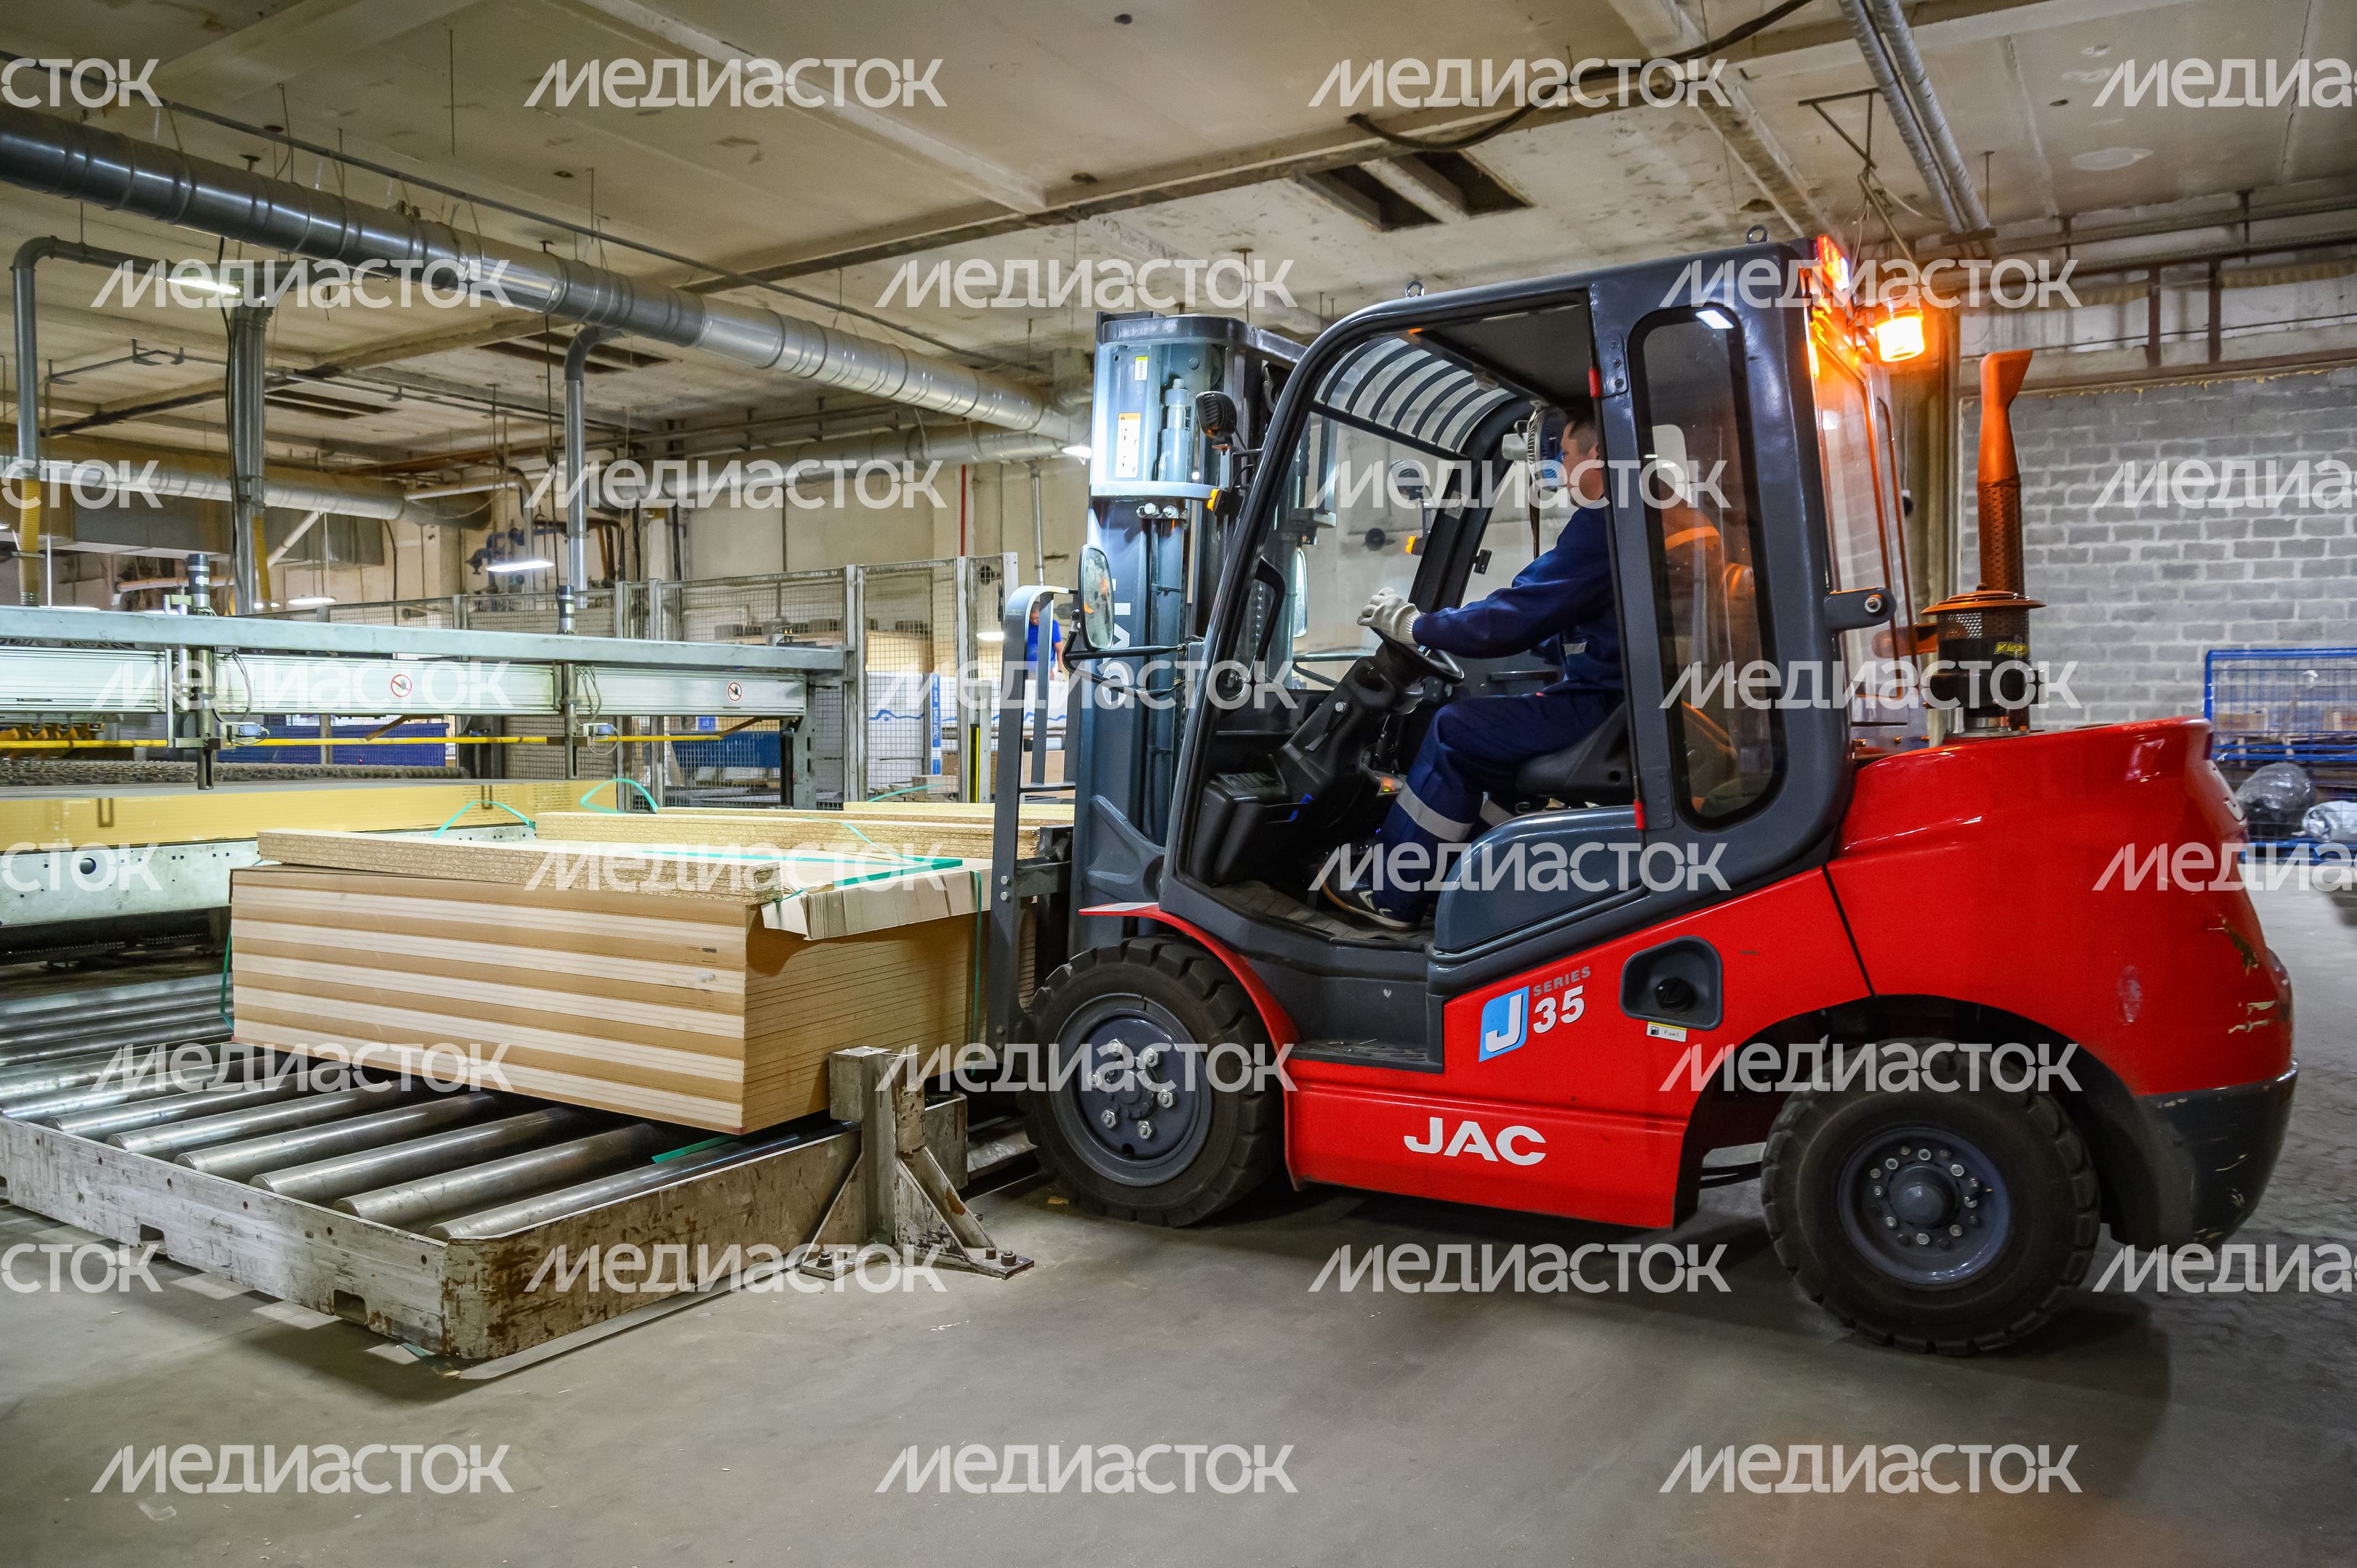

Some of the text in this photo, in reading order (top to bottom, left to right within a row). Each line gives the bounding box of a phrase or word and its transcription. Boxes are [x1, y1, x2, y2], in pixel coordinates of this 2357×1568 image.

[1533, 966, 1591, 997] SERIES
[1485, 984, 1586, 1053] J 35
[1404, 1116, 1547, 1166] JAC
